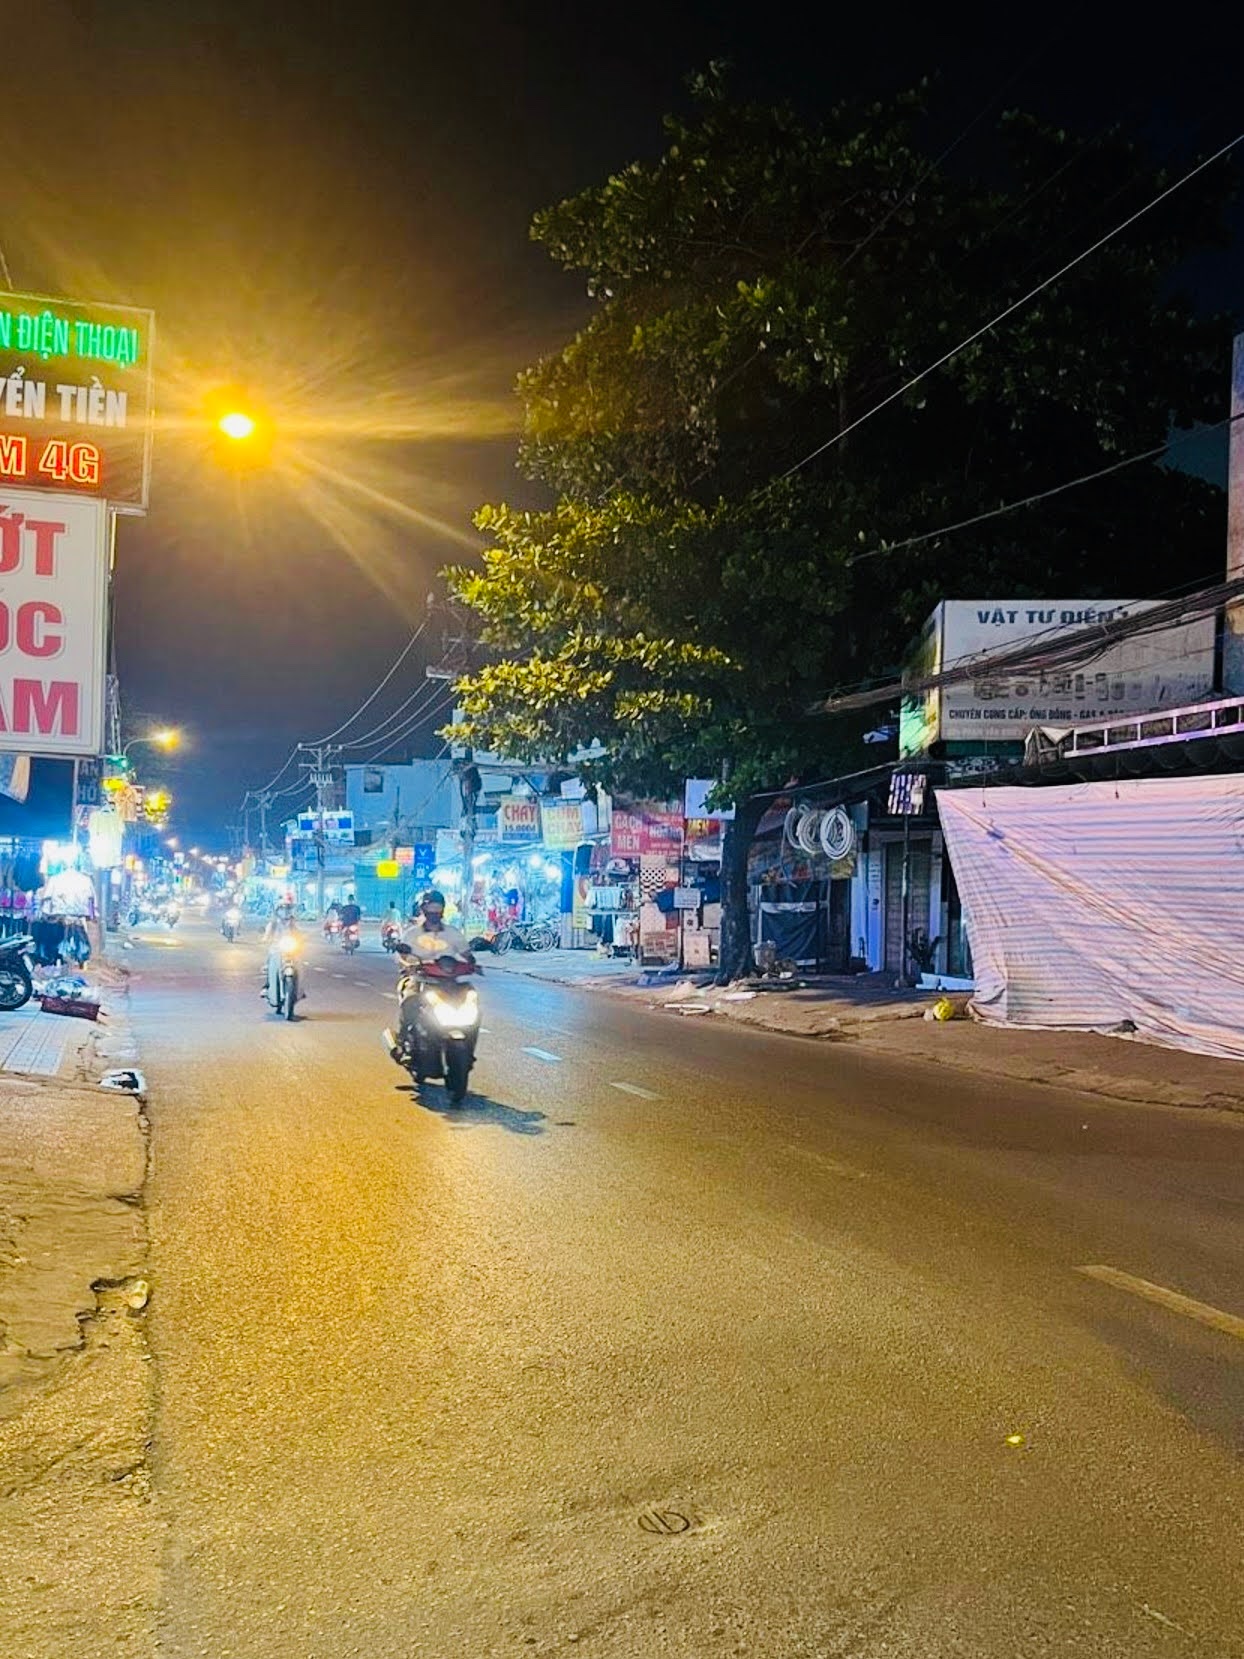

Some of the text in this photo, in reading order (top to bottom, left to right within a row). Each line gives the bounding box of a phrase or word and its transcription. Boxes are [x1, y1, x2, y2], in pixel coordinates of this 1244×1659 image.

[17, 310, 69, 360] ĐIỆN
[75, 321, 138, 369] THOẠI
[56, 375, 128, 429] TIỀN
[38, 440, 99, 484] 4G
[977, 608, 1019, 627] VẬT
[1026, 609, 1056, 625] TƯ
[0, 678, 78, 735] M
